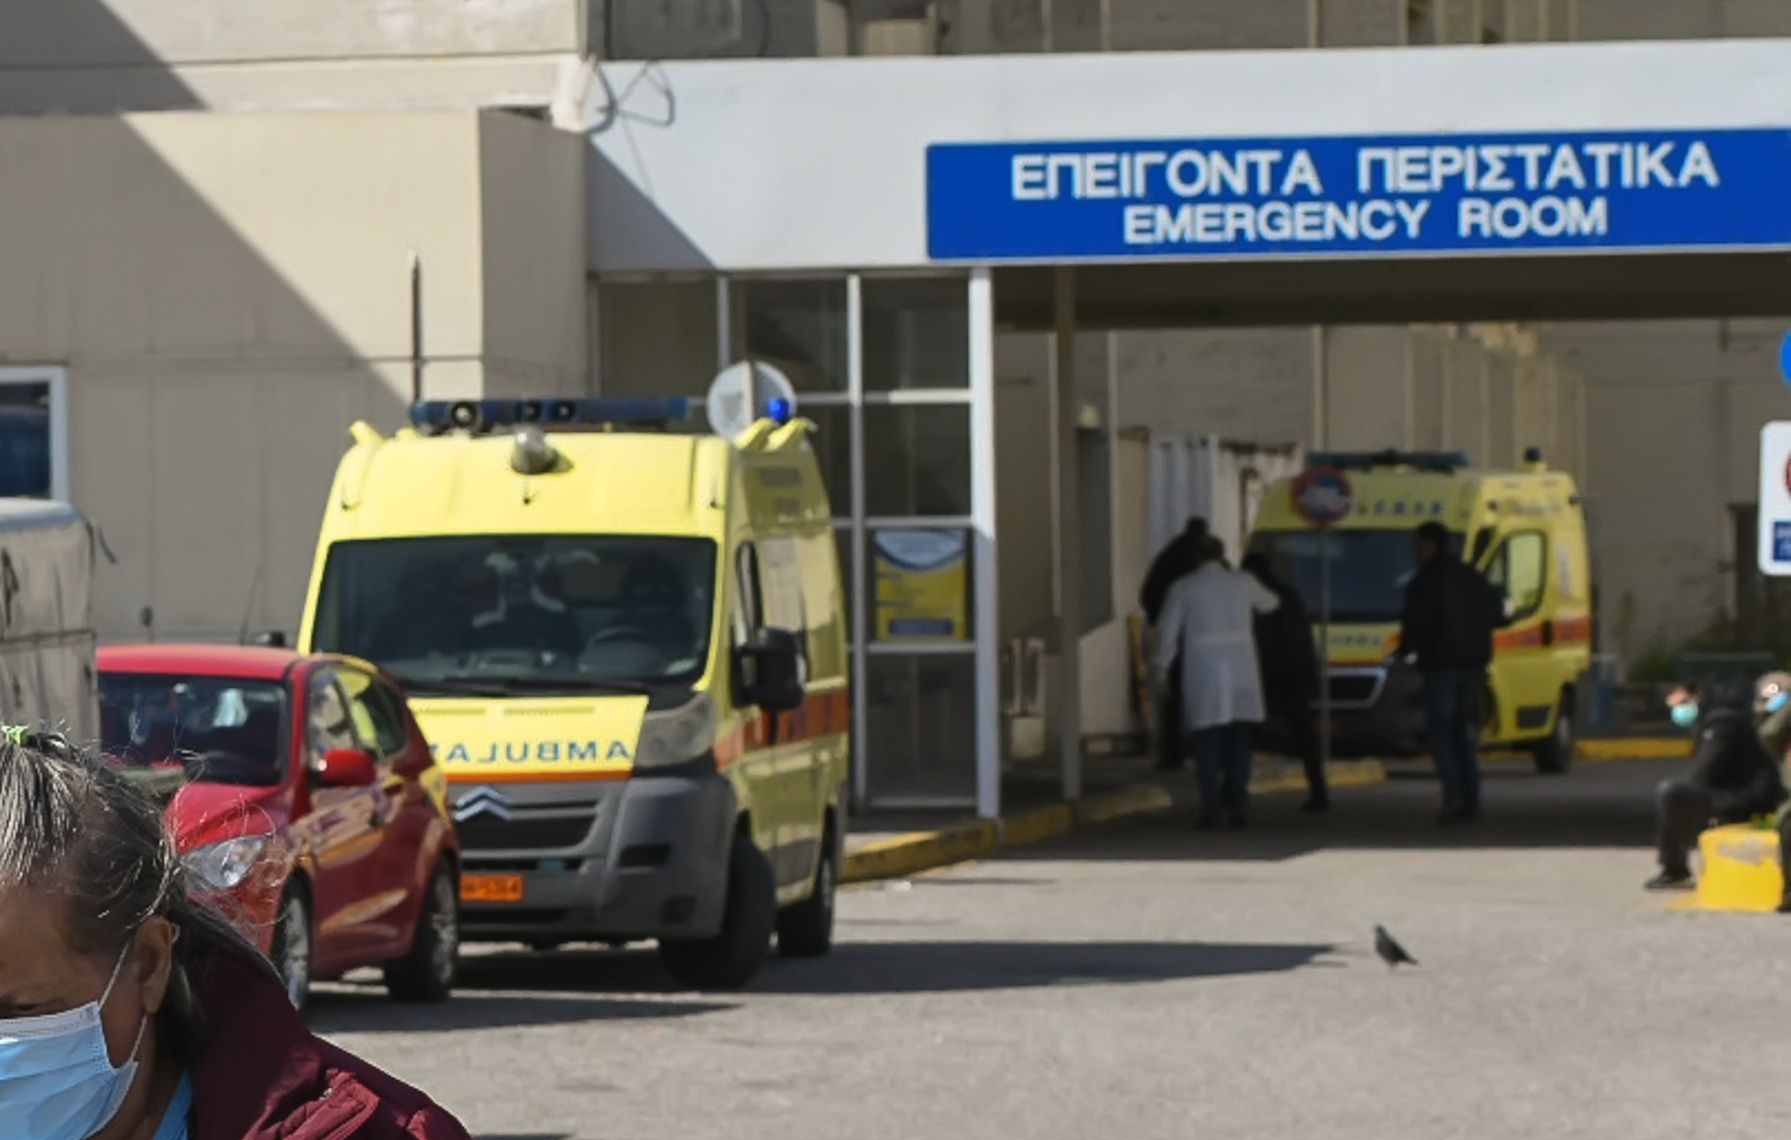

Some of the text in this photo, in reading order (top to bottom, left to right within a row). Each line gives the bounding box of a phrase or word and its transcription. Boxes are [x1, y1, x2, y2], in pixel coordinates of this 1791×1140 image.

[1011, 140, 1721, 200] ΕΠΕΙΓΟΝΤΑ ΠΕΡΙΣΤΑΤΙΚΑ
[1123, 195, 1608, 244] EMERGENCY ROOM
